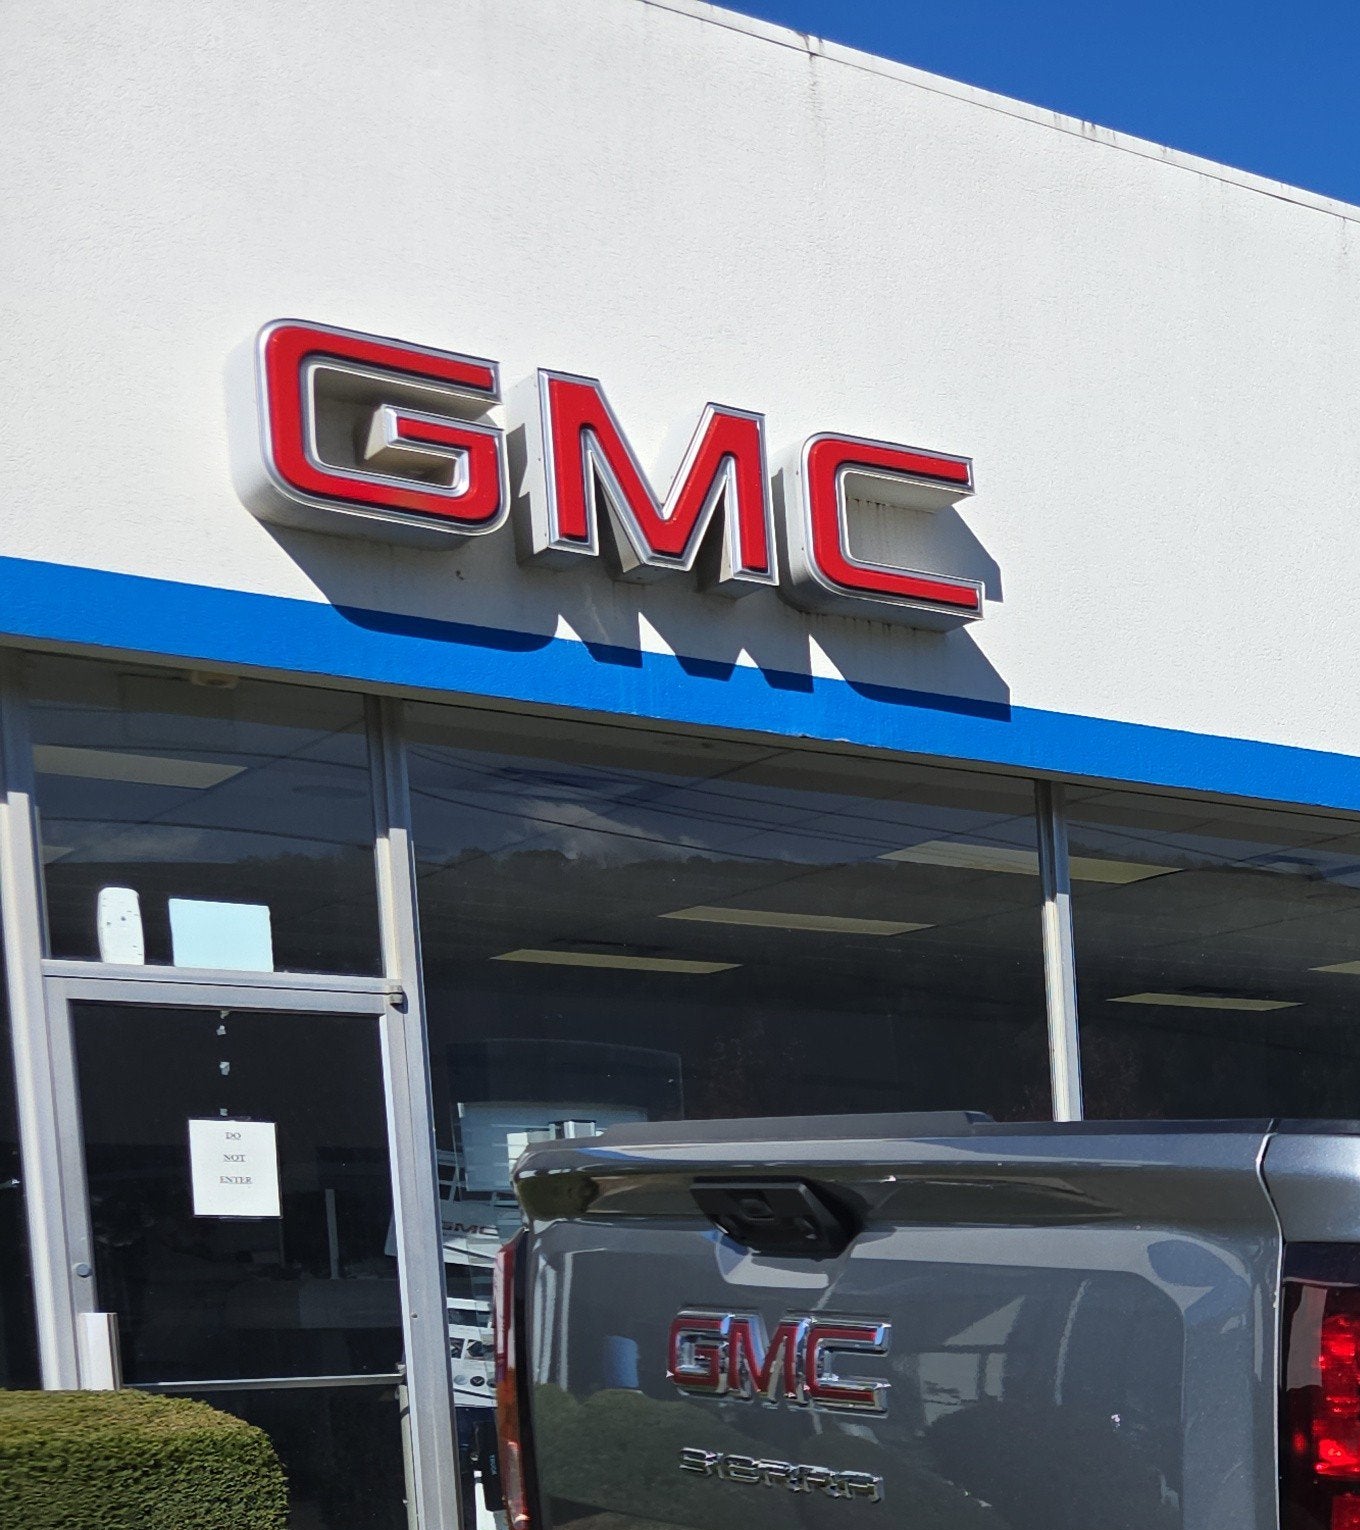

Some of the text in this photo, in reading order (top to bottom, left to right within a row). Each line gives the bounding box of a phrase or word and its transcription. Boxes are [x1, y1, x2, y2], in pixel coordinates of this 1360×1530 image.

[254, 317, 986, 624] GMC
[225, 1131, 242, 1141] DO
[223, 1154, 247, 1163] NOT
[219, 1175, 253, 1185] ENTER
[667, 1308, 891, 1414] GMC
[679, 1447, 885, 1503] SIERRA
